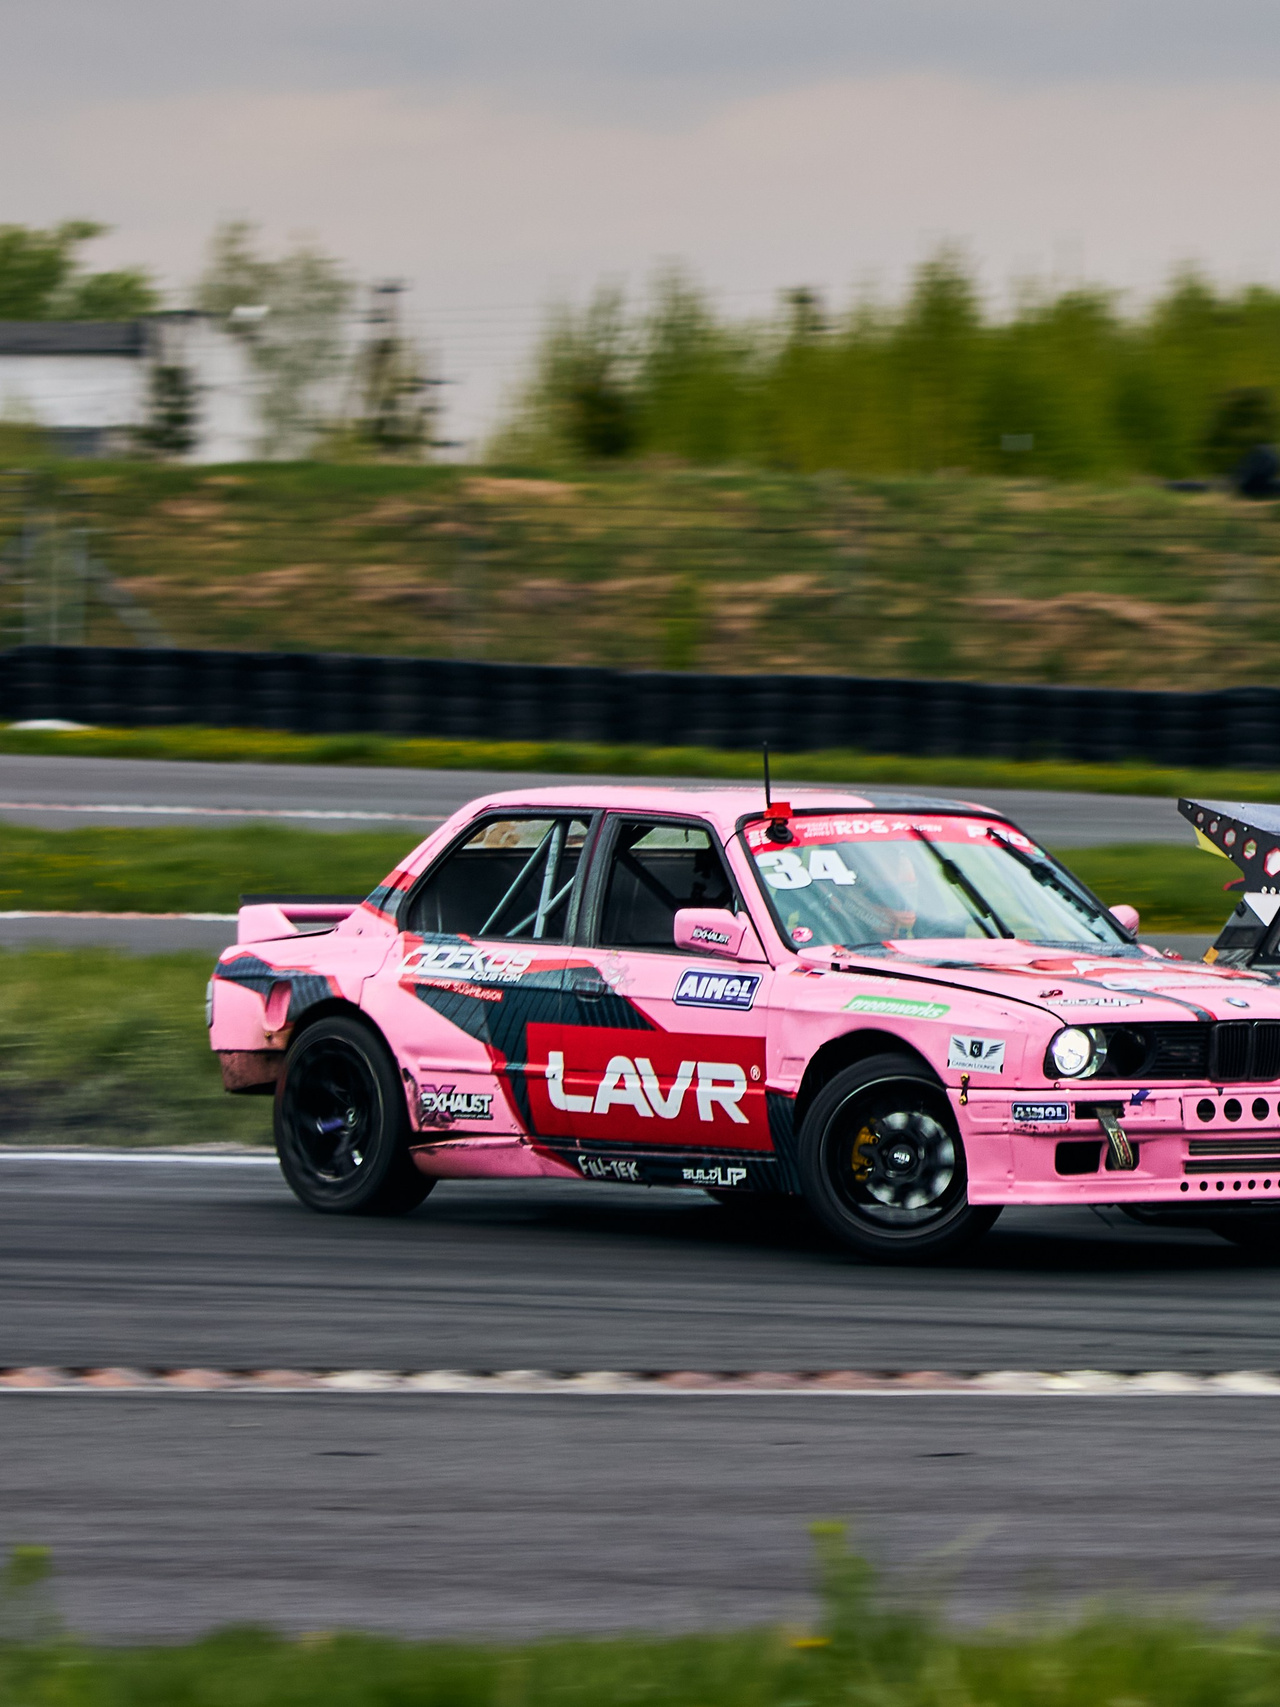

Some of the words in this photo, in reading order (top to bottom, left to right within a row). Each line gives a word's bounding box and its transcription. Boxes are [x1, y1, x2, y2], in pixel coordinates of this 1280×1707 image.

[833, 820, 889, 835] RDS
[755, 850, 857, 890] 34
[472, 972, 524, 983] CUSTOM
[677, 975, 752, 1002] AIMOL
[545, 1051, 750, 1124] LAVR
[420, 1092, 493, 1114] EXHAUST
